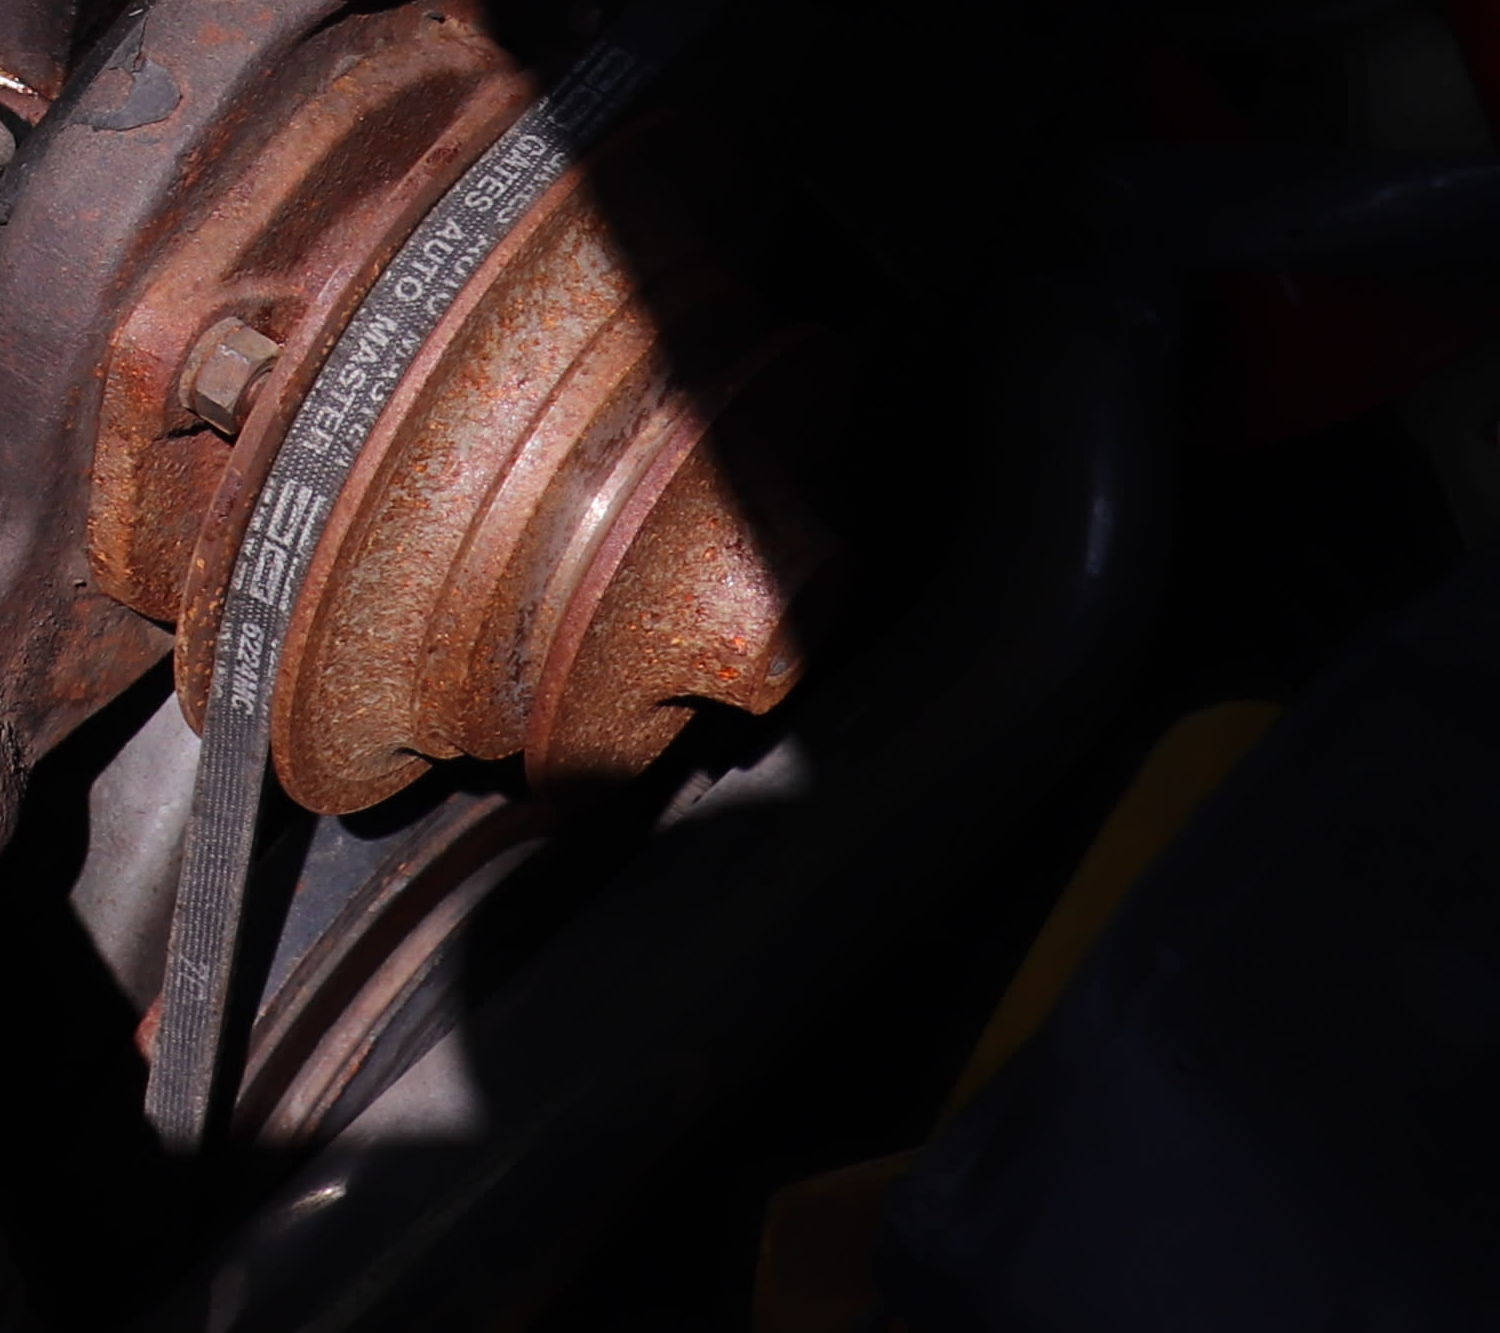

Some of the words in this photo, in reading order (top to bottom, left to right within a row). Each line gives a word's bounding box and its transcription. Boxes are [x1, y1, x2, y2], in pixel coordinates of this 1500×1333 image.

[465, 134, 548, 213] GATES
[395, 217, 465, 302] AUTO
[302, 314, 399, 455] MASTER
[230, 622, 265, 717] 6224MC
